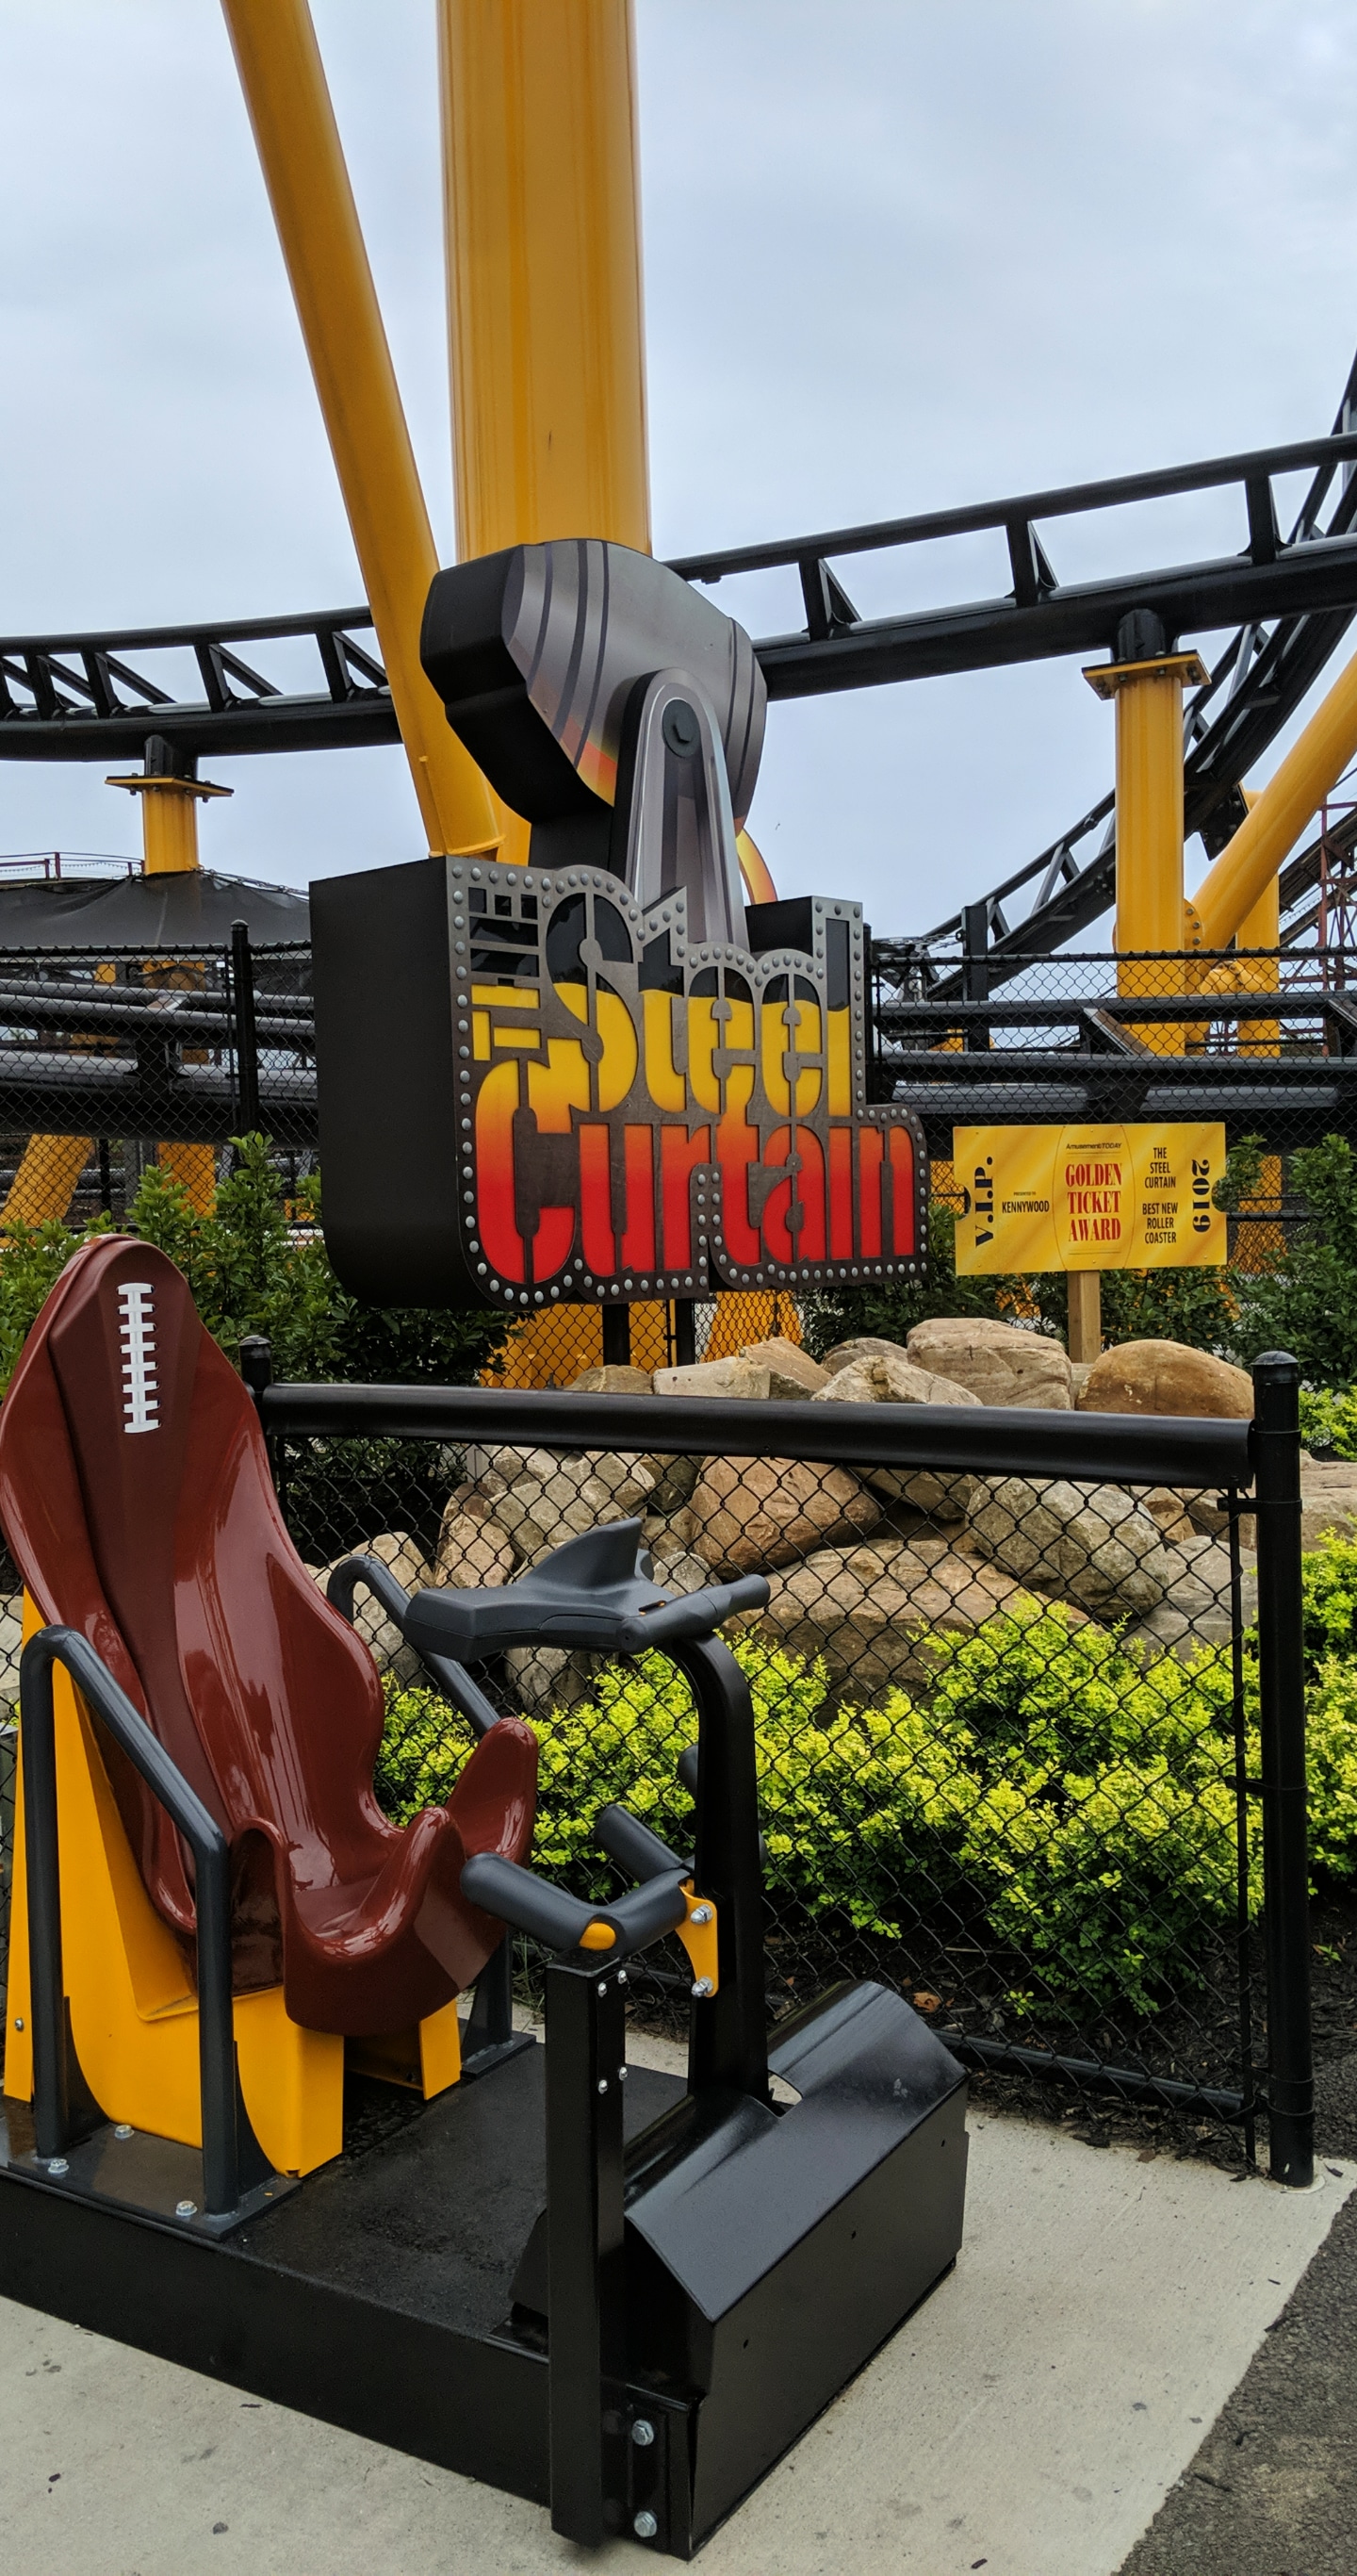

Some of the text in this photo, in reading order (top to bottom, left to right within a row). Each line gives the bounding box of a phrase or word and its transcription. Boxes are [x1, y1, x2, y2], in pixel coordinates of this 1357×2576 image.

[546, 892, 852, 1118] Steel
[1153, 1147, 1168, 1159] THE
[475, 1059, 915, 1284] Curtain
[1065, 1162, 1122, 1188] GOLDEN
[1150, 1161, 1170, 1174] STEEL
[1144, 1176, 1176, 1190] CURTAIN
[974, 1156, 993, 1248] V.I.P.
[1067, 1190, 1121, 1215] TICKET
[1192, 1158, 1211, 1233] 2019
[1002, 1200, 1050, 1214] KENNYWOOD
[1142, 1202, 1178, 1215] BEST NEW
[1068, 1218, 1121, 1242] AWARD
[1146, 1217, 1174, 1230] ROLLER
[1144, 1231, 1177, 1244] COASTER
